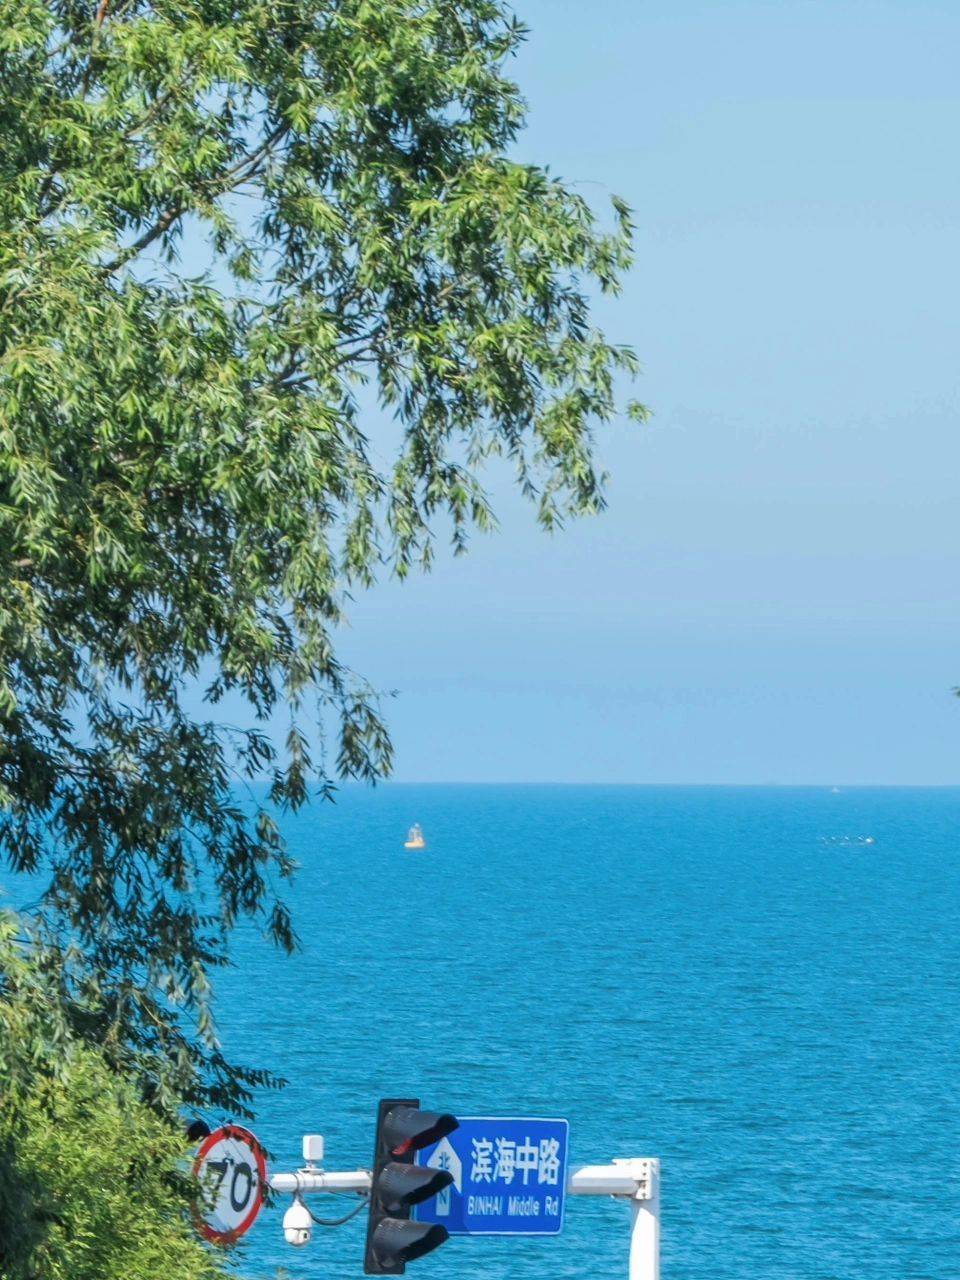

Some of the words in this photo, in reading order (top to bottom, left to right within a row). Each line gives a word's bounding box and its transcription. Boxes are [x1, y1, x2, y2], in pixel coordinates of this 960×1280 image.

[438, 1152, 450, 1170] 北
[470, 1136, 560, 1186] 滨海中路
[206, 1161, 252, 1213] 70
[467, 1195, 503, 1216] BINHAI
[508, 1195, 540, 1216] Middle
[544, 1195, 560, 1216] Rd
